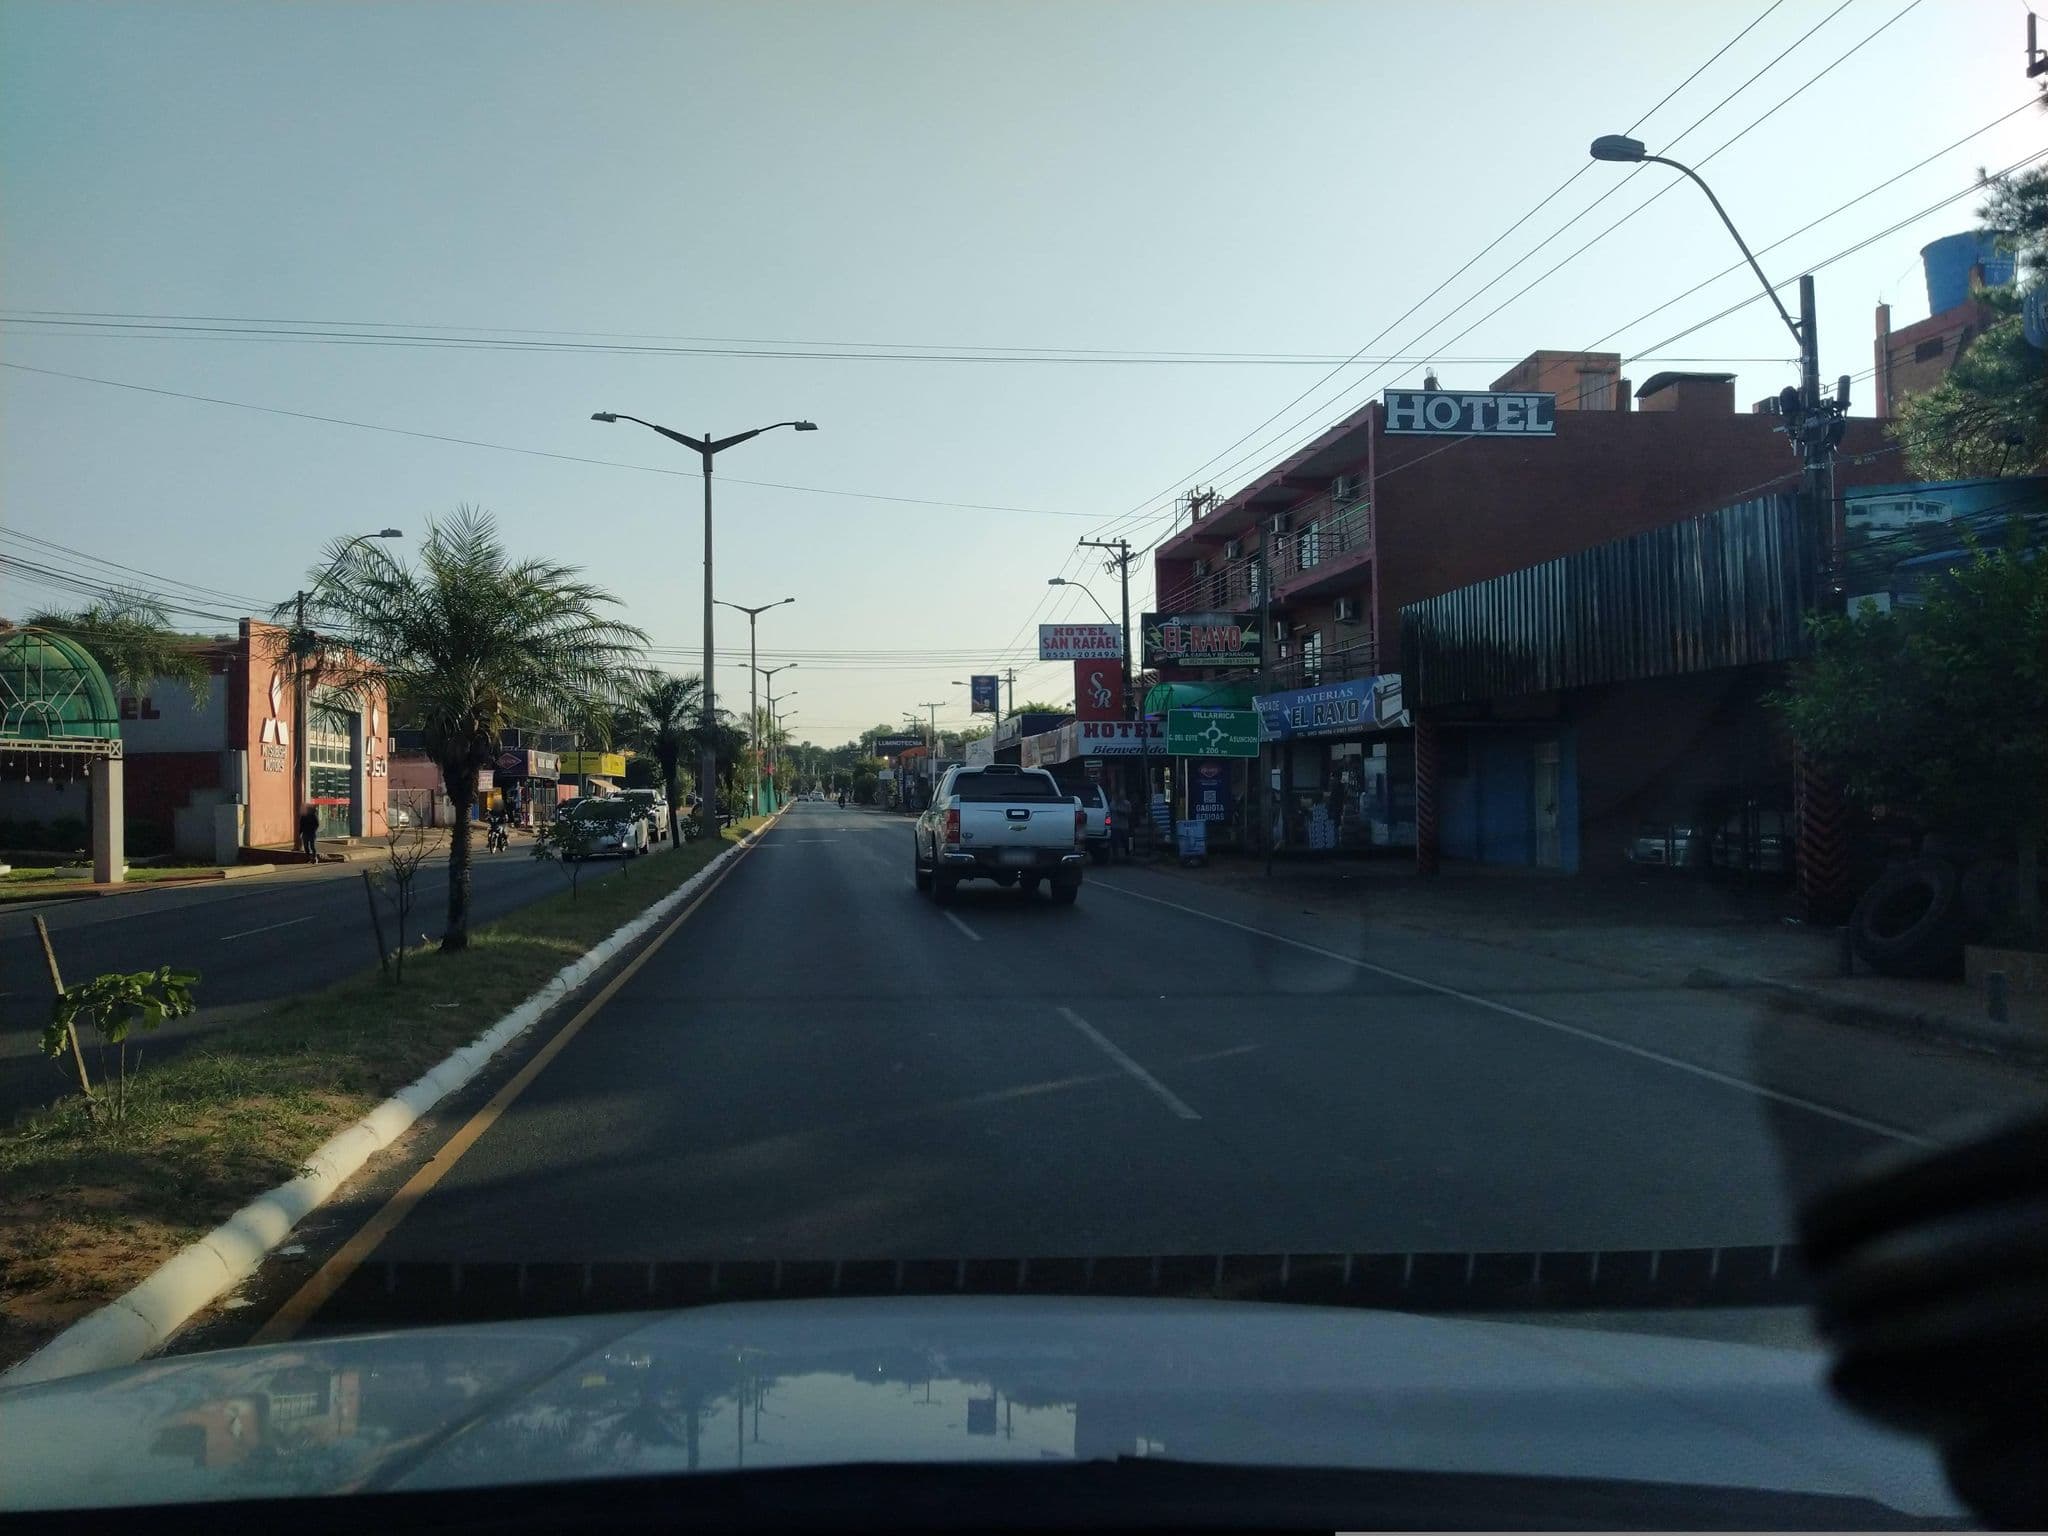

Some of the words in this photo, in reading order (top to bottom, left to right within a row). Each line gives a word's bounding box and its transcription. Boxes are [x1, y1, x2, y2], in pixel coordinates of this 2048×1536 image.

[1386, 394, 1553, 431] HOTEL
[1053, 627, 1108, 636] HOTEL
[1163, 626, 1184, 653] EL
[1190, 624, 1242, 652] RAYO
[1043, 637, 1068, 649] SAN
[1073, 636, 1118, 649] RAFAEL
[1297, 687, 1353, 704] BATERIAS
[1193, 711, 1235, 719] VILLARRICA
[1290, 705, 1309, 728] EL
[1313, 699, 1360, 726] RAYO
[1083, 722, 1164, 738] HOTEL
